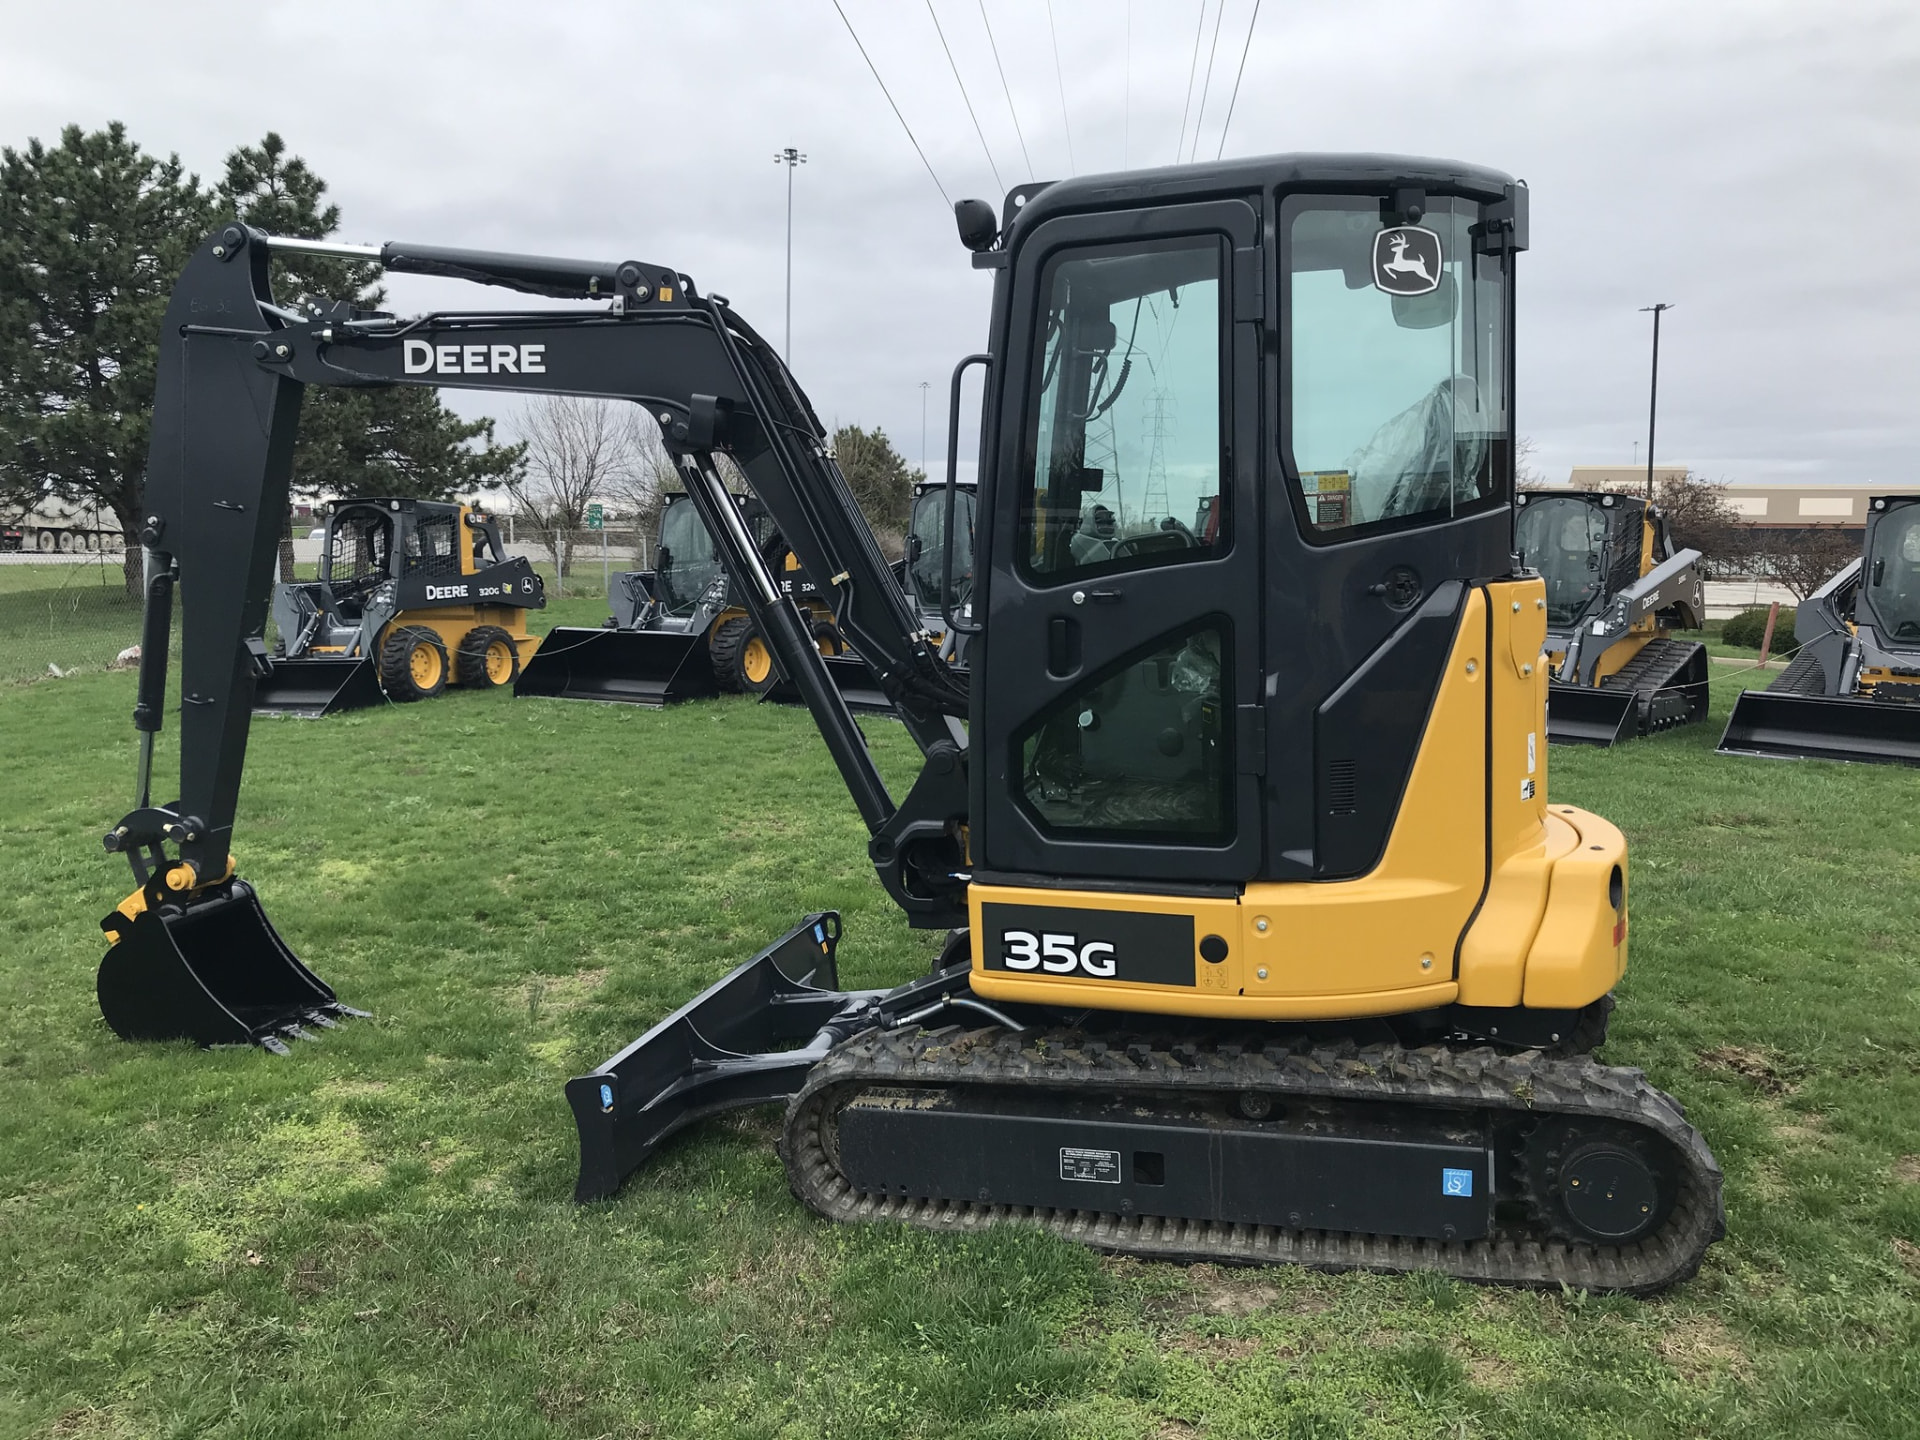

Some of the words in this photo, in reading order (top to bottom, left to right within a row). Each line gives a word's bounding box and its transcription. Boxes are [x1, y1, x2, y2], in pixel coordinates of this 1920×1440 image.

[404, 339, 546, 374] DEERE
[426, 585, 469, 600] DEERE
[479, 587, 500, 597] 320G
[801, 583, 816, 592] 324
[1642, 590, 1660, 610] DEERE
[1004, 931, 1116, 977] 35G
